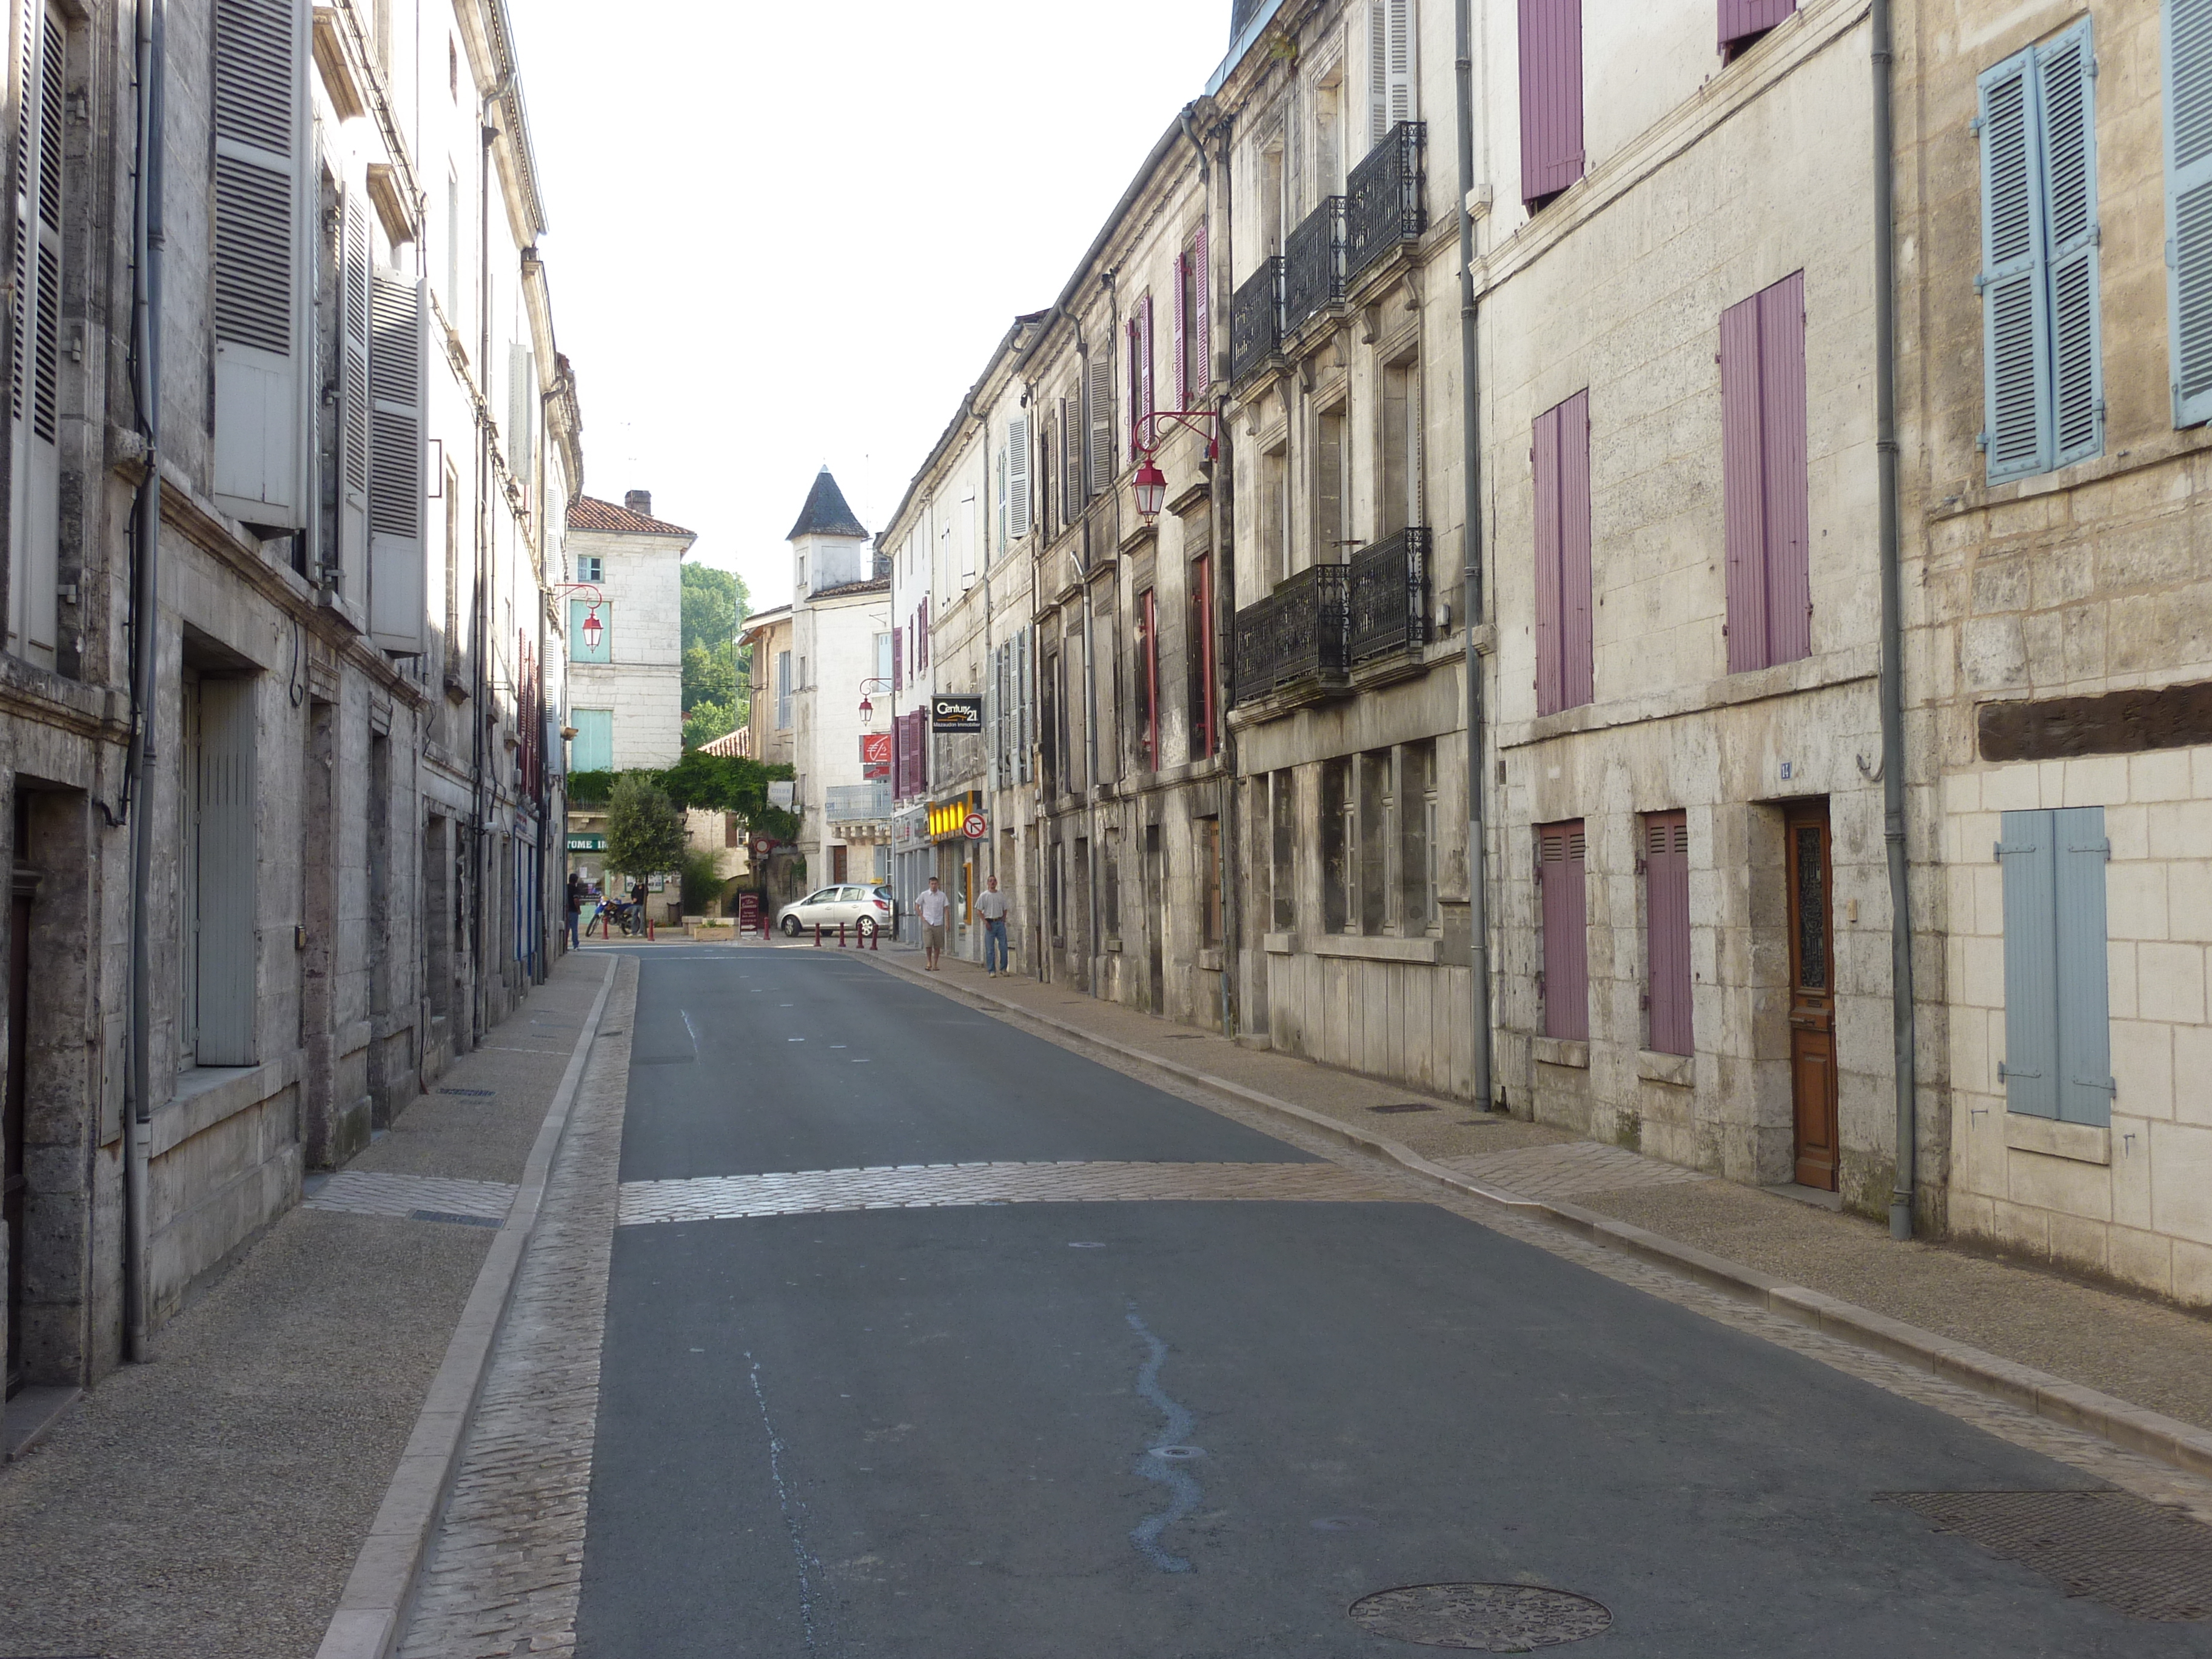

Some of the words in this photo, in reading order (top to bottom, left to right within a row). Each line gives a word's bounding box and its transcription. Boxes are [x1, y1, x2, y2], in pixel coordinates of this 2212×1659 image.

[937, 702, 970, 715] Century
[967, 709, 977, 722] 21
[1781, 764, 1789, 778] 14
